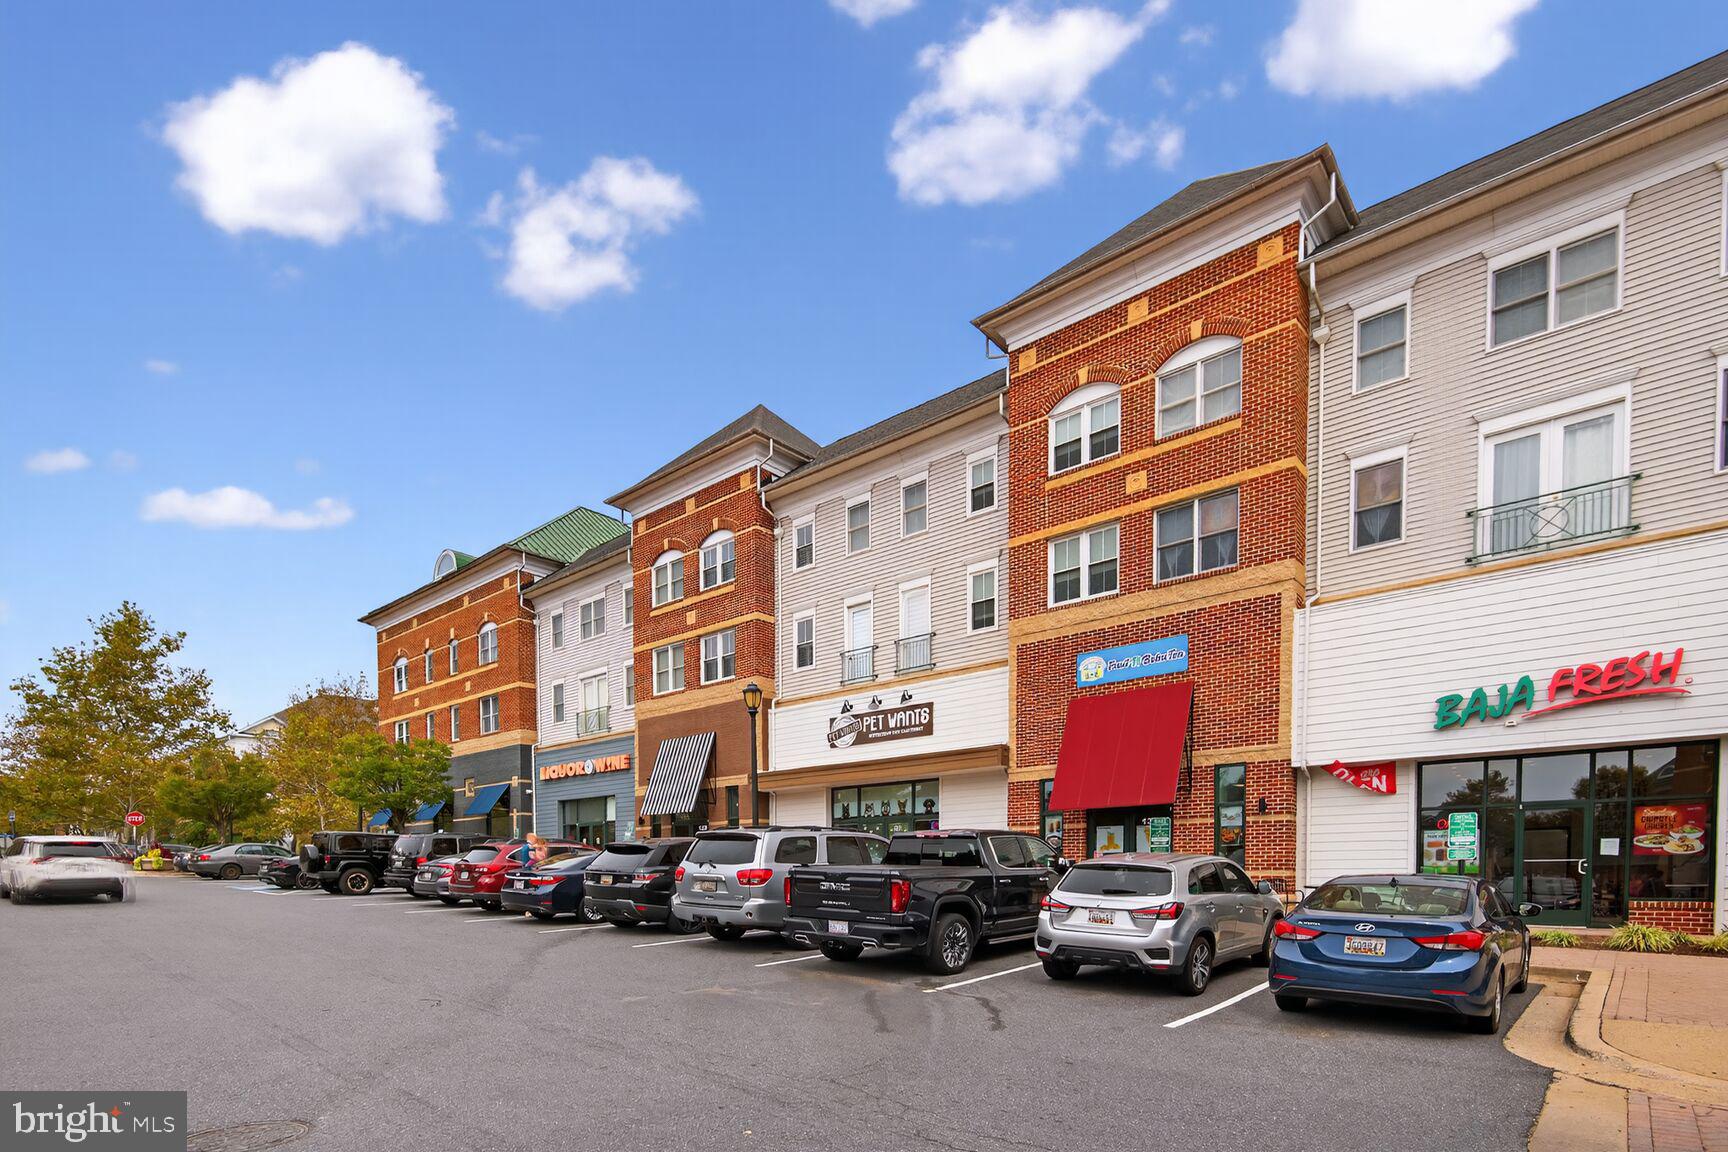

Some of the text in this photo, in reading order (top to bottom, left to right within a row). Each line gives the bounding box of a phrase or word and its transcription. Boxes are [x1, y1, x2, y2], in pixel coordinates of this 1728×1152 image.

[1434, 648, 1684, 729] BAJA FRESH
[863, 714, 884, 732] PET
[888, 707, 930, 728] WANTS
[540, 754, 630, 780] LIQUOR WINE
